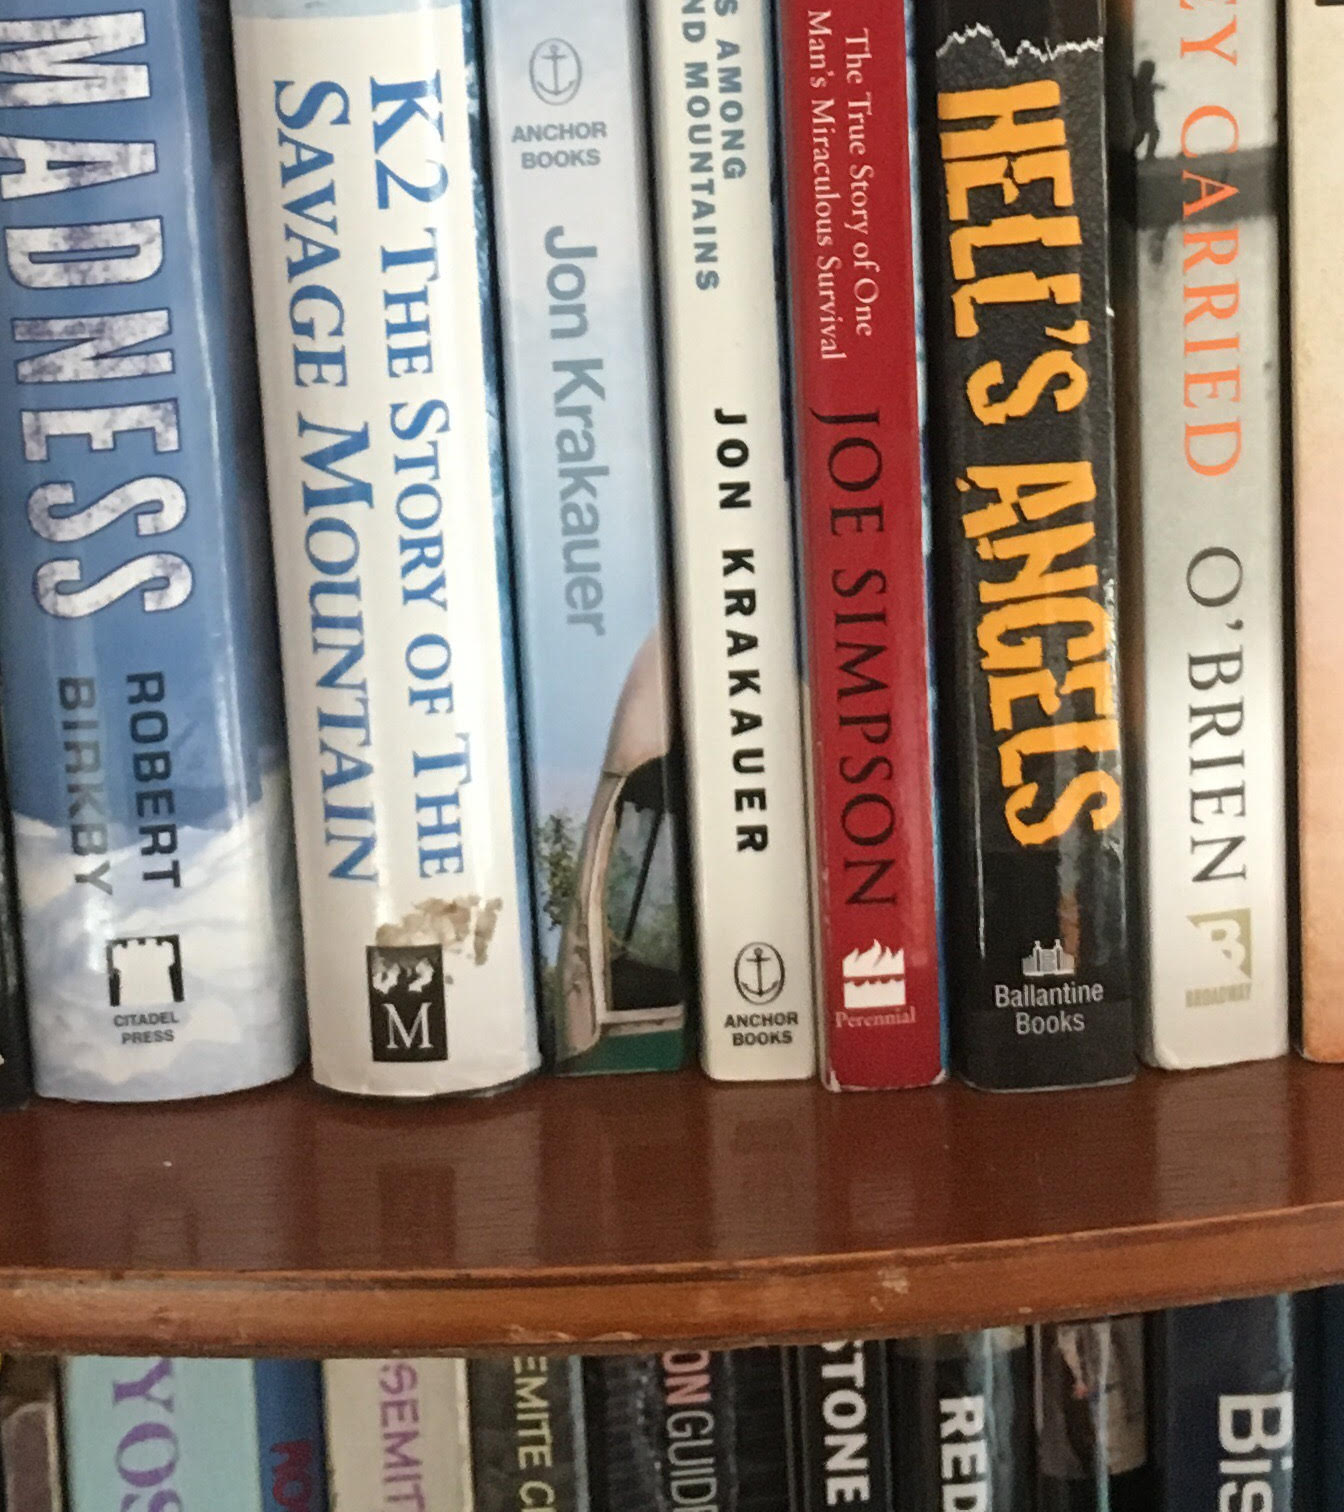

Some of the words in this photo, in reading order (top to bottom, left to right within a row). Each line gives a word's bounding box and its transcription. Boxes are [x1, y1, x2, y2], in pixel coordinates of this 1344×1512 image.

[807, 10, 833, 89] Man's
[843, 28, 872, 86] The
[369, 69, 450, 210] K2
[511, 121, 607, 142] ANCHOR
[521, 148, 600, 170] BOOKS
[715, 40, 746, 180] AMONG
[847, 92, 873, 155] True
[684, 62, 720, 292] MOUNTAINS
[811, 97, 838, 249] Miraculous
[846, 162, 876, 238] Story
[273, 79, 350, 387] SAVAGE
[544, 225, 598, 339] Jon
[853, 241, 878, 277] of
[380, 227, 442, 379] THE
[816, 256, 846, 360] Survival
[853, 279, 880, 338] One
[1180, 104, 1242, 477] CARRIED
[388, 398, 450, 612] STORY
[551, 358, 611, 637] Krakauer
[714, 409, 752, 509] JON
[810, 407, 884, 537] JOE
[297, 409, 379, 882] MOUNTAIN
[405, 633, 454, 715] OF
[721, 547, 768, 854] KRAKAUER
[957, 460, 1122, 848] ANGELS
[831, 569, 897, 908] SIMPSON
[1186, 547, 1247, 883] O'BRIEN
[58, 676, 113, 895] BIRKBY
[126, 670, 181, 888] ROBERT
[413, 732, 471, 879] THE
[113, 1010, 178, 1028] CITADEL
[121, 1028, 175, 1044] PRESS
[724, 1010, 799, 1028] ANCHOR
[732, 1030, 793, 1046] BOOKS
[836, 1006, 915, 1027] Perennial
[994, 980, 1104, 1009] Ballantine
[1014, 1010, 1086, 1036] Books
